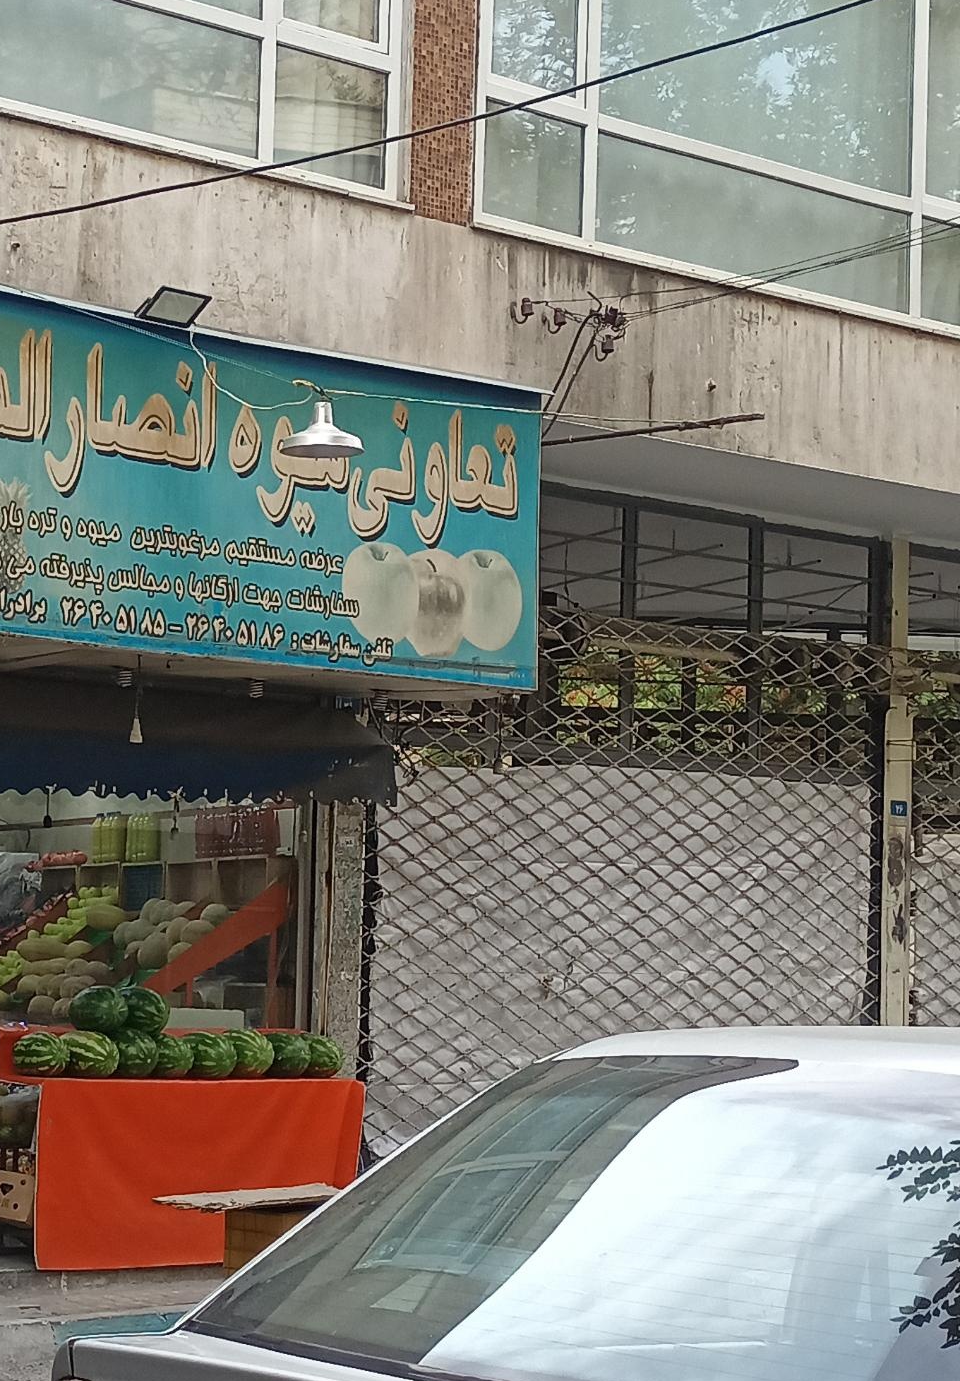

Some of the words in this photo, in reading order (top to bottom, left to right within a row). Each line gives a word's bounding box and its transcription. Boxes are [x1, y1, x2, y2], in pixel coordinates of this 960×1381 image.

[44, 342, 218, 496] انصار
[1, 501, 24, 533] بار
[28, 507, 57, 537] تره
[61, 516, 73, 540] و
[76, 520, 122, 547] میوه
[130, 525, 220, 559] مرغوبترین
[6, 555, 35, 580] می
[225, 537, 296, 568] مستقیم
[300, 547, 344, 578] عرضه
[39, 553, 104, 595] پذیرفته
[107, 564, 171, 598] مجالس
[174, 577, 184, 602] و
[188, 572, 240, 608] ارگانها
[243, 582, 282, 612] جهت
[286, 585, 360, 619] سفارشات
[362, 637, 394, 666] تلفن
